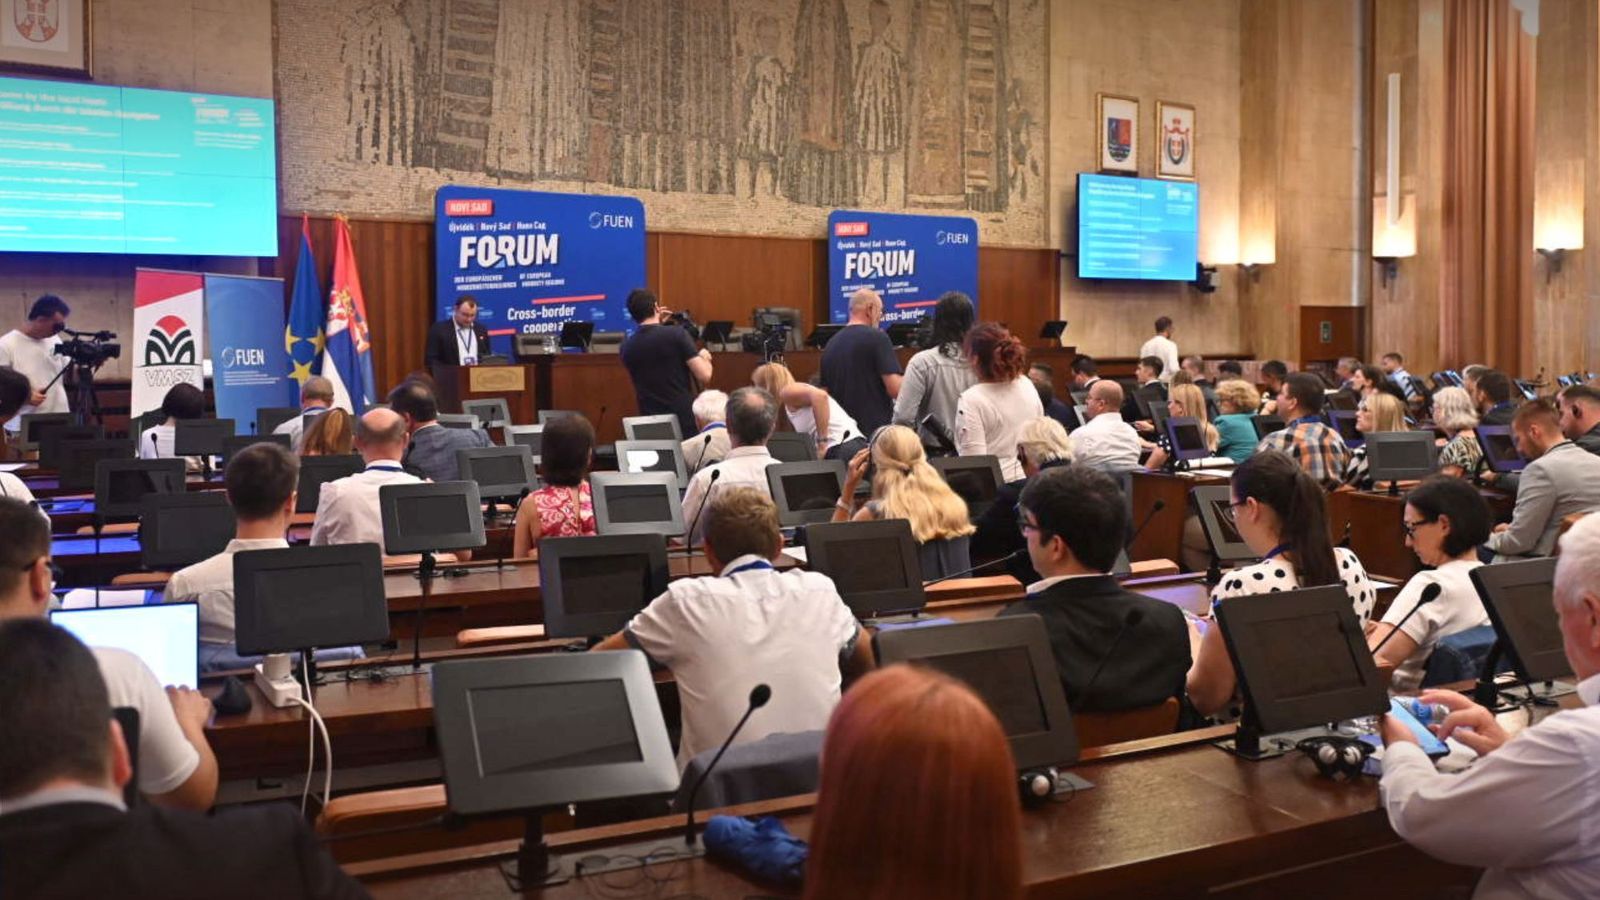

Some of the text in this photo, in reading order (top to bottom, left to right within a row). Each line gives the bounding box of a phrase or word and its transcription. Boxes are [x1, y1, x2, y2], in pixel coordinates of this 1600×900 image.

[450, 202, 488, 212] NOVI SAD
[480, 222, 497, 232] Nový
[498, 221, 511, 231] Sad
[603, 214, 633, 228] FUEN
[946, 232, 969, 245] FUEN
[459, 233, 559, 269] FORUM
[844, 249, 915, 279] FORUM
[506, 304, 577, 321] Cross-border
[235, 348, 265, 366] FUEN
[144, 368, 195, 388] VMSZ
